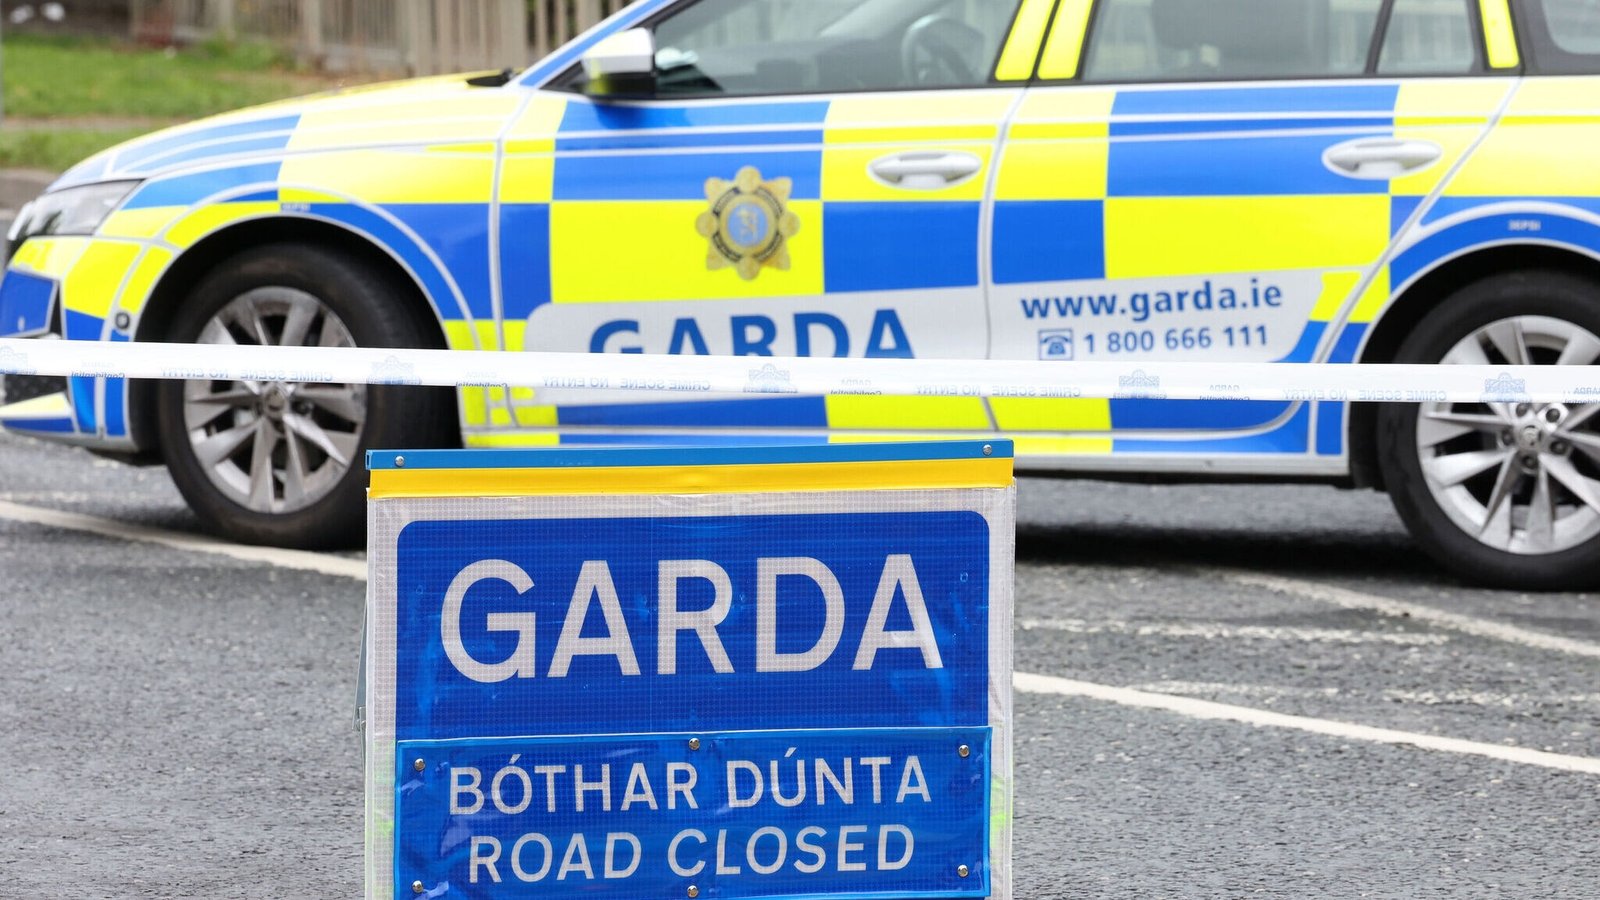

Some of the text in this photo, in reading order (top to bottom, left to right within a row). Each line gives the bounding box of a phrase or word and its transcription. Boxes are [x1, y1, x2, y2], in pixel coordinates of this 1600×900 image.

[1020, 278, 1283, 322] www.garda.ie
[588, 308, 915, 359] GARDA
[1083, 325, 1267, 354] 1 800 666 111
[440, 553, 945, 684] GARDA
[448, 746, 933, 816] BÓTHAR DÚNTA
[468, 823, 916, 884] ROAD CLOSED
